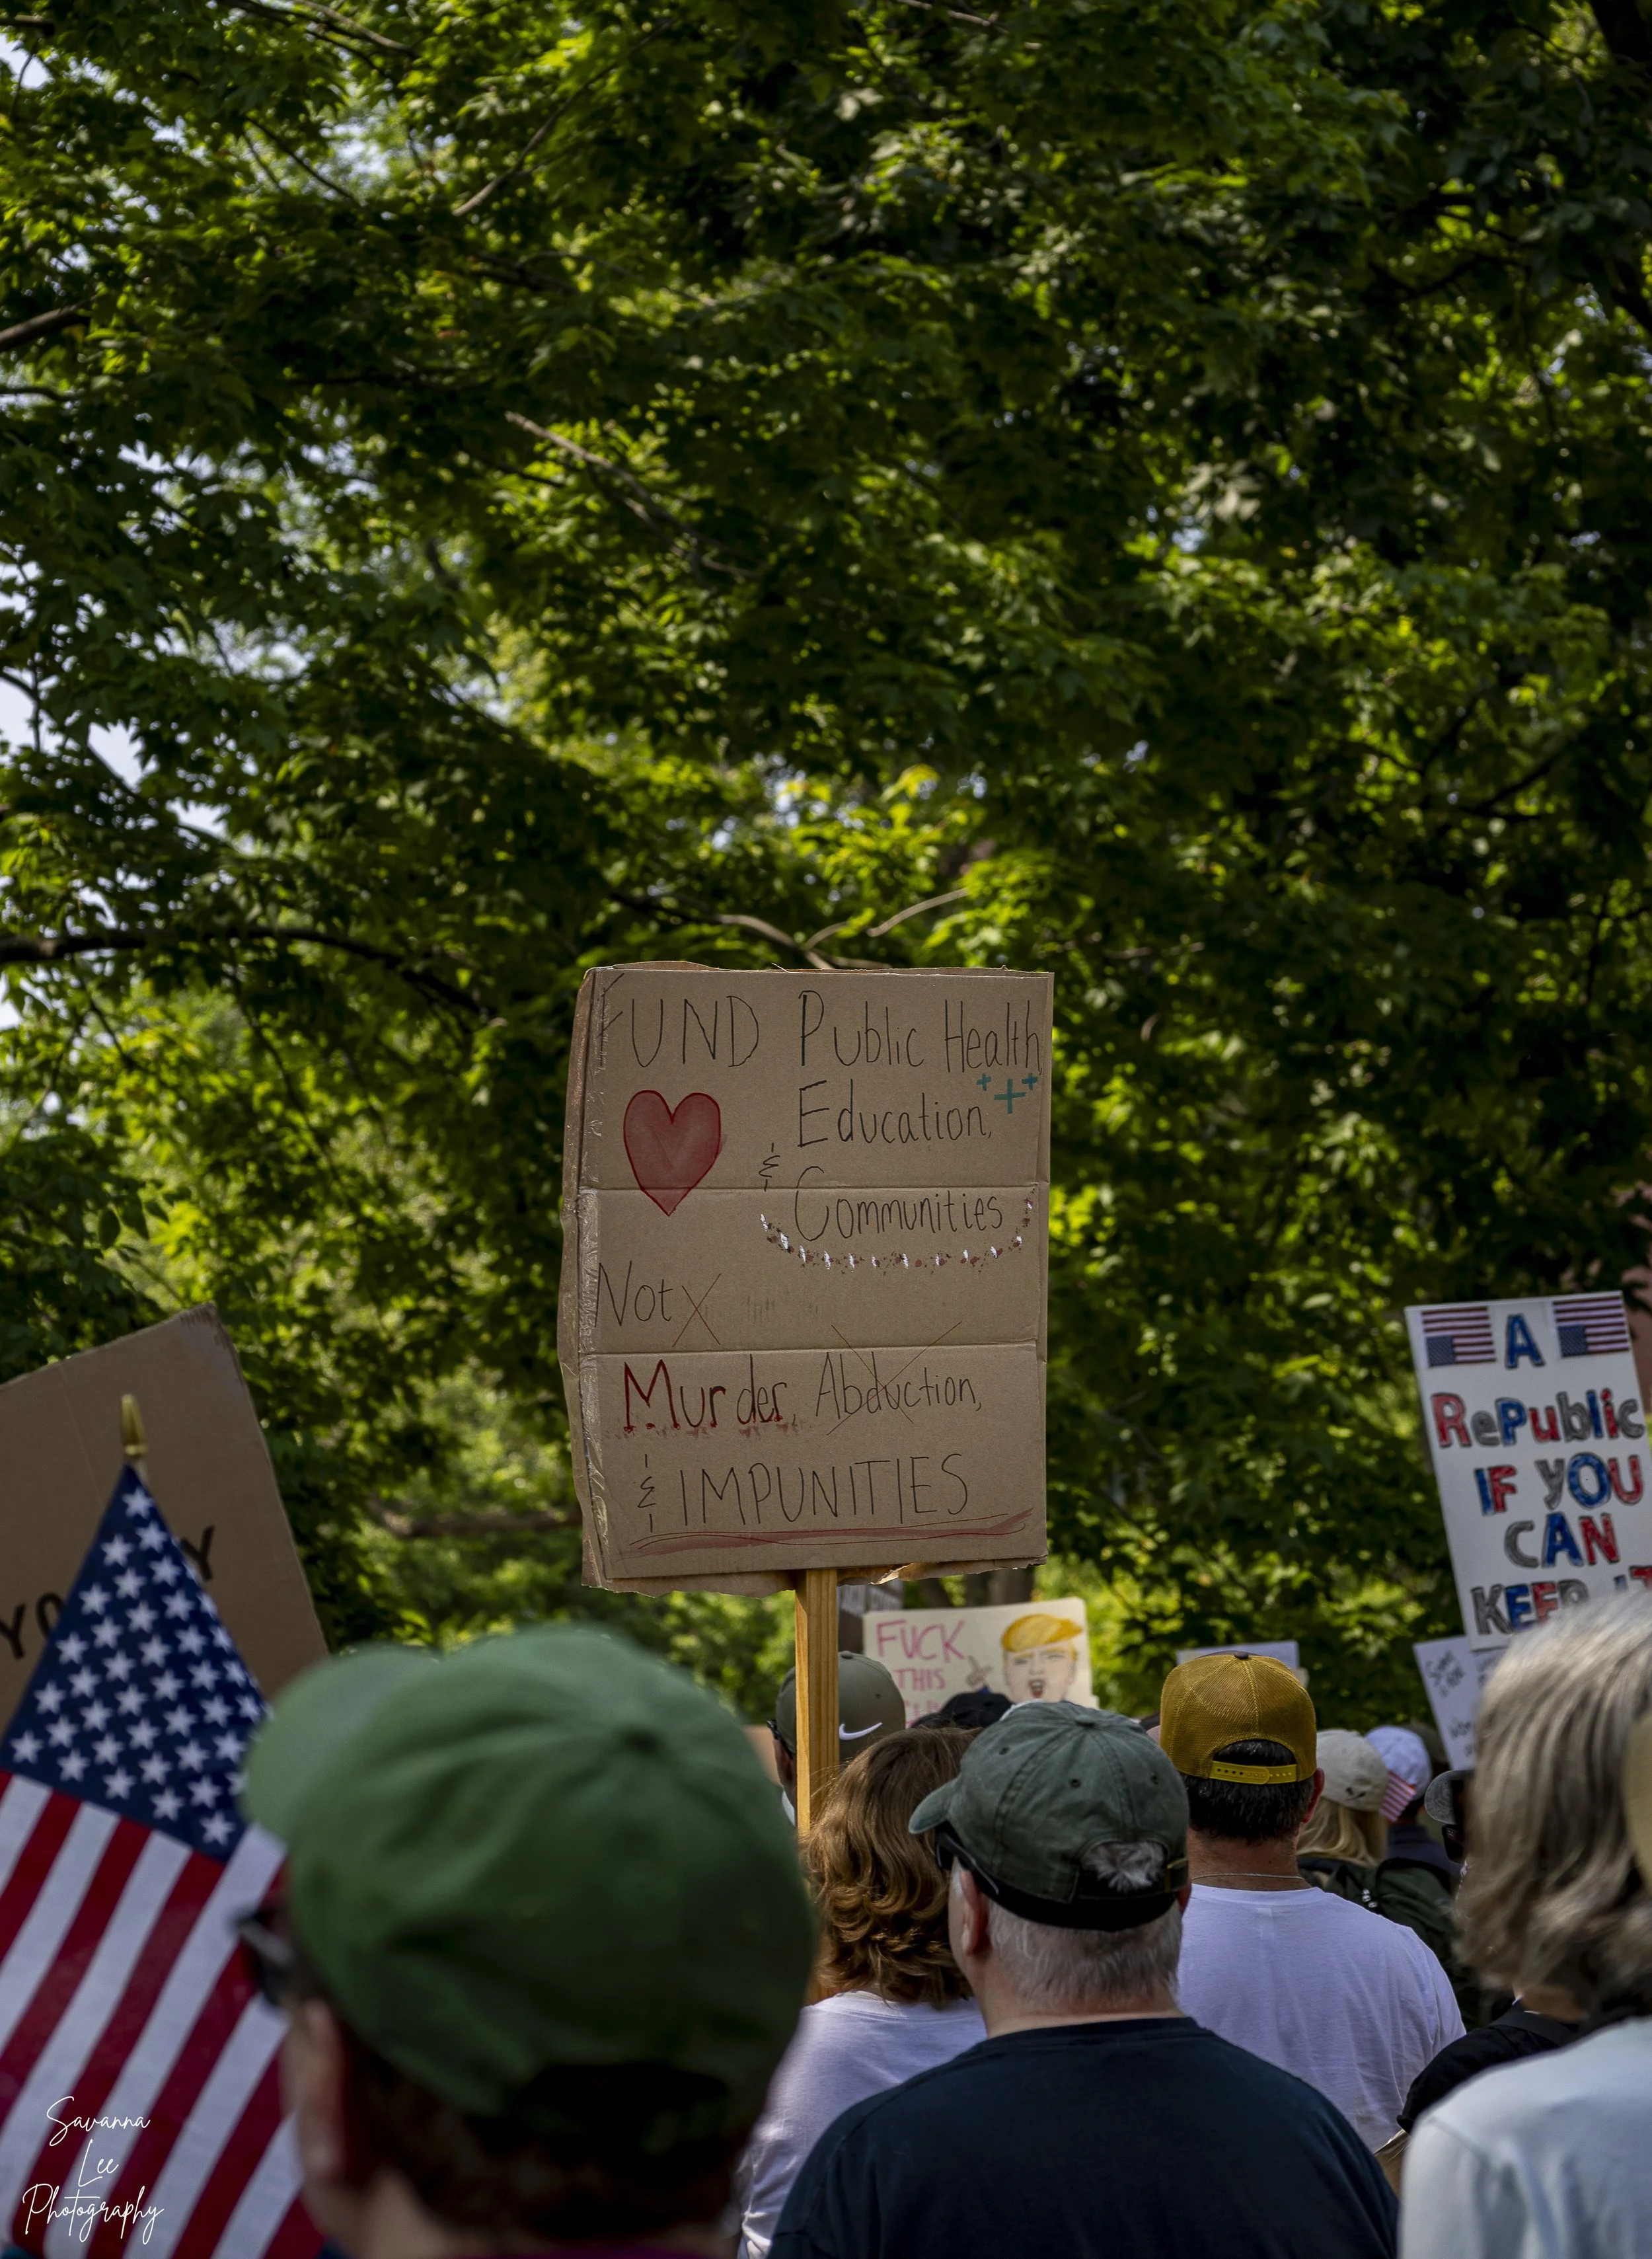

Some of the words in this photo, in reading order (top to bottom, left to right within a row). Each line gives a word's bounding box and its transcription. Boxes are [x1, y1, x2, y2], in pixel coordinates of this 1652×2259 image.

[597, 972, 759, 1068] FUND
[799, 990, 925, 1067] Public
[798, 1079, 992, 1148] Education,
[795, 1166, 1003, 1242] Communities
[595, 1260, 673, 1328] Not
[1504, 1313, 1546, 1369] A
[815, 1350, 983, 1422] Abduction,
[679, 1453, 969, 1526] IMPUNITIES
[1474, 1465, 1517, 1516] IF
[1503, 1512, 1620, 1569] CAN
[876, 1619, 965, 1664] FUCK
[892, 1667, 946, 1692] THIS
